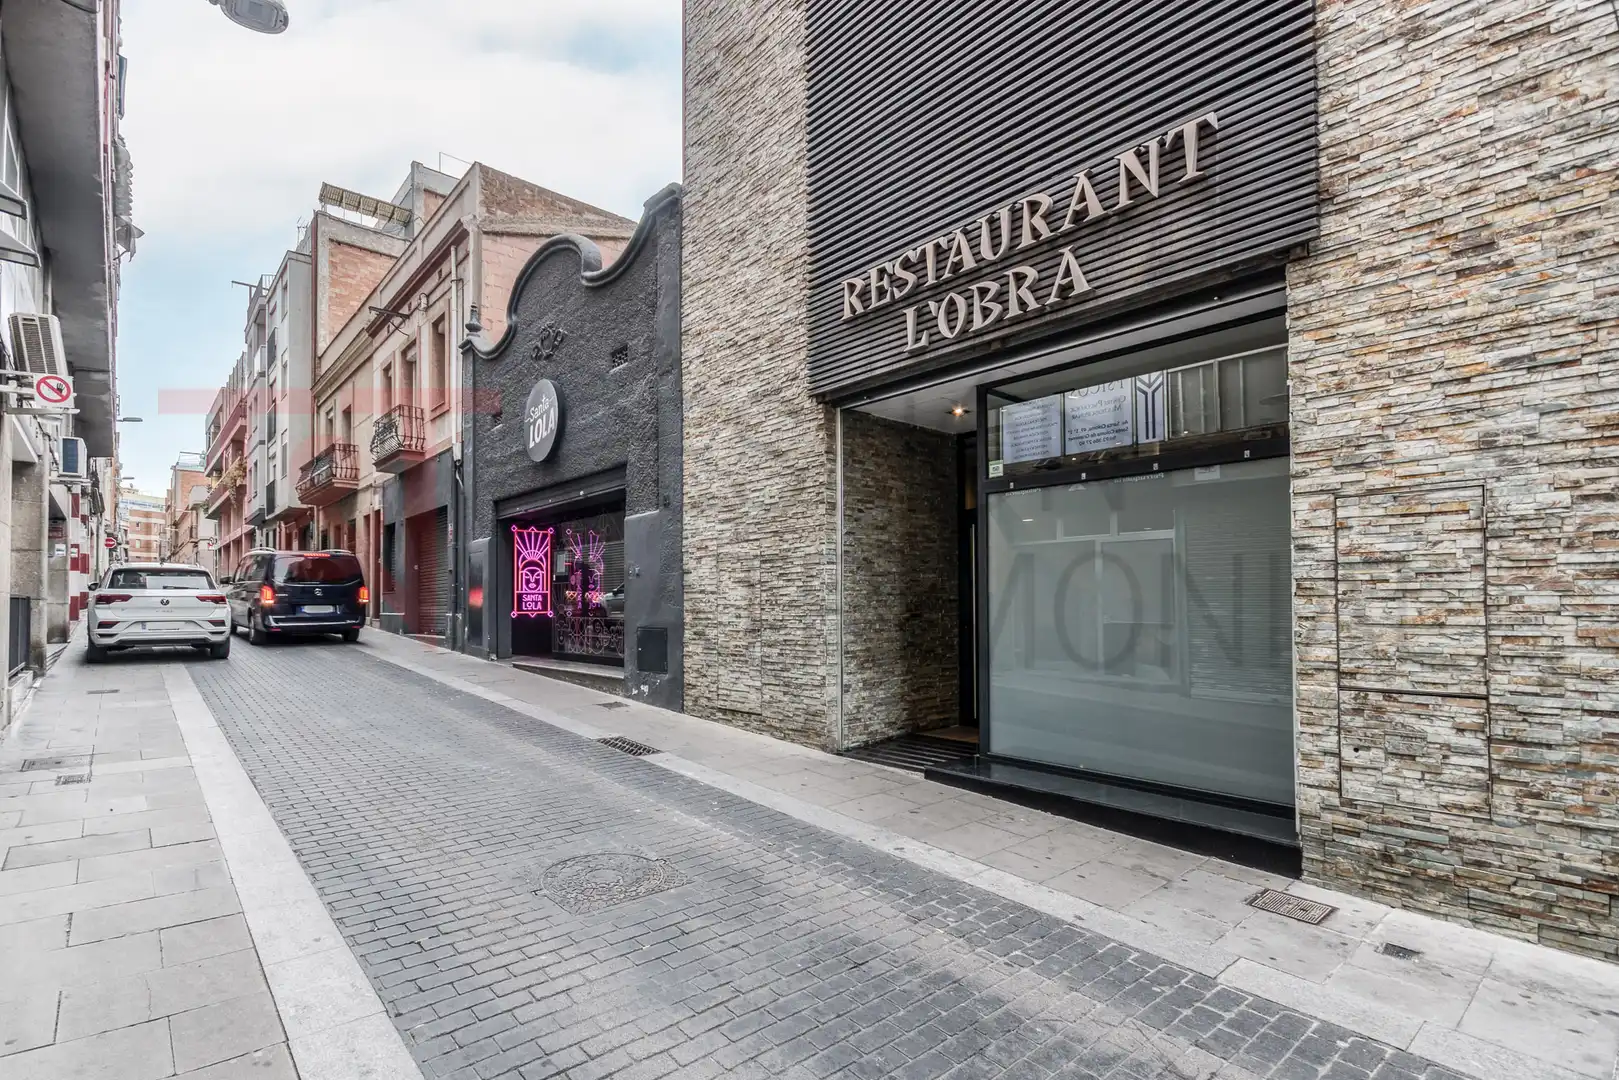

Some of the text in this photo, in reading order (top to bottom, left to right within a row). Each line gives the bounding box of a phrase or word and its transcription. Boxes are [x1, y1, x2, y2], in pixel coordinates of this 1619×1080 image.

[841, 112, 1218, 321] RESTAURANT
[903, 245, 1094, 352] L'OBRA
[527, 394, 552, 422] Santa
[529, 407, 555, 449] LOLA
[522, 594, 543, 602] SANTA
[522, 602, 542, 610] LOLA
